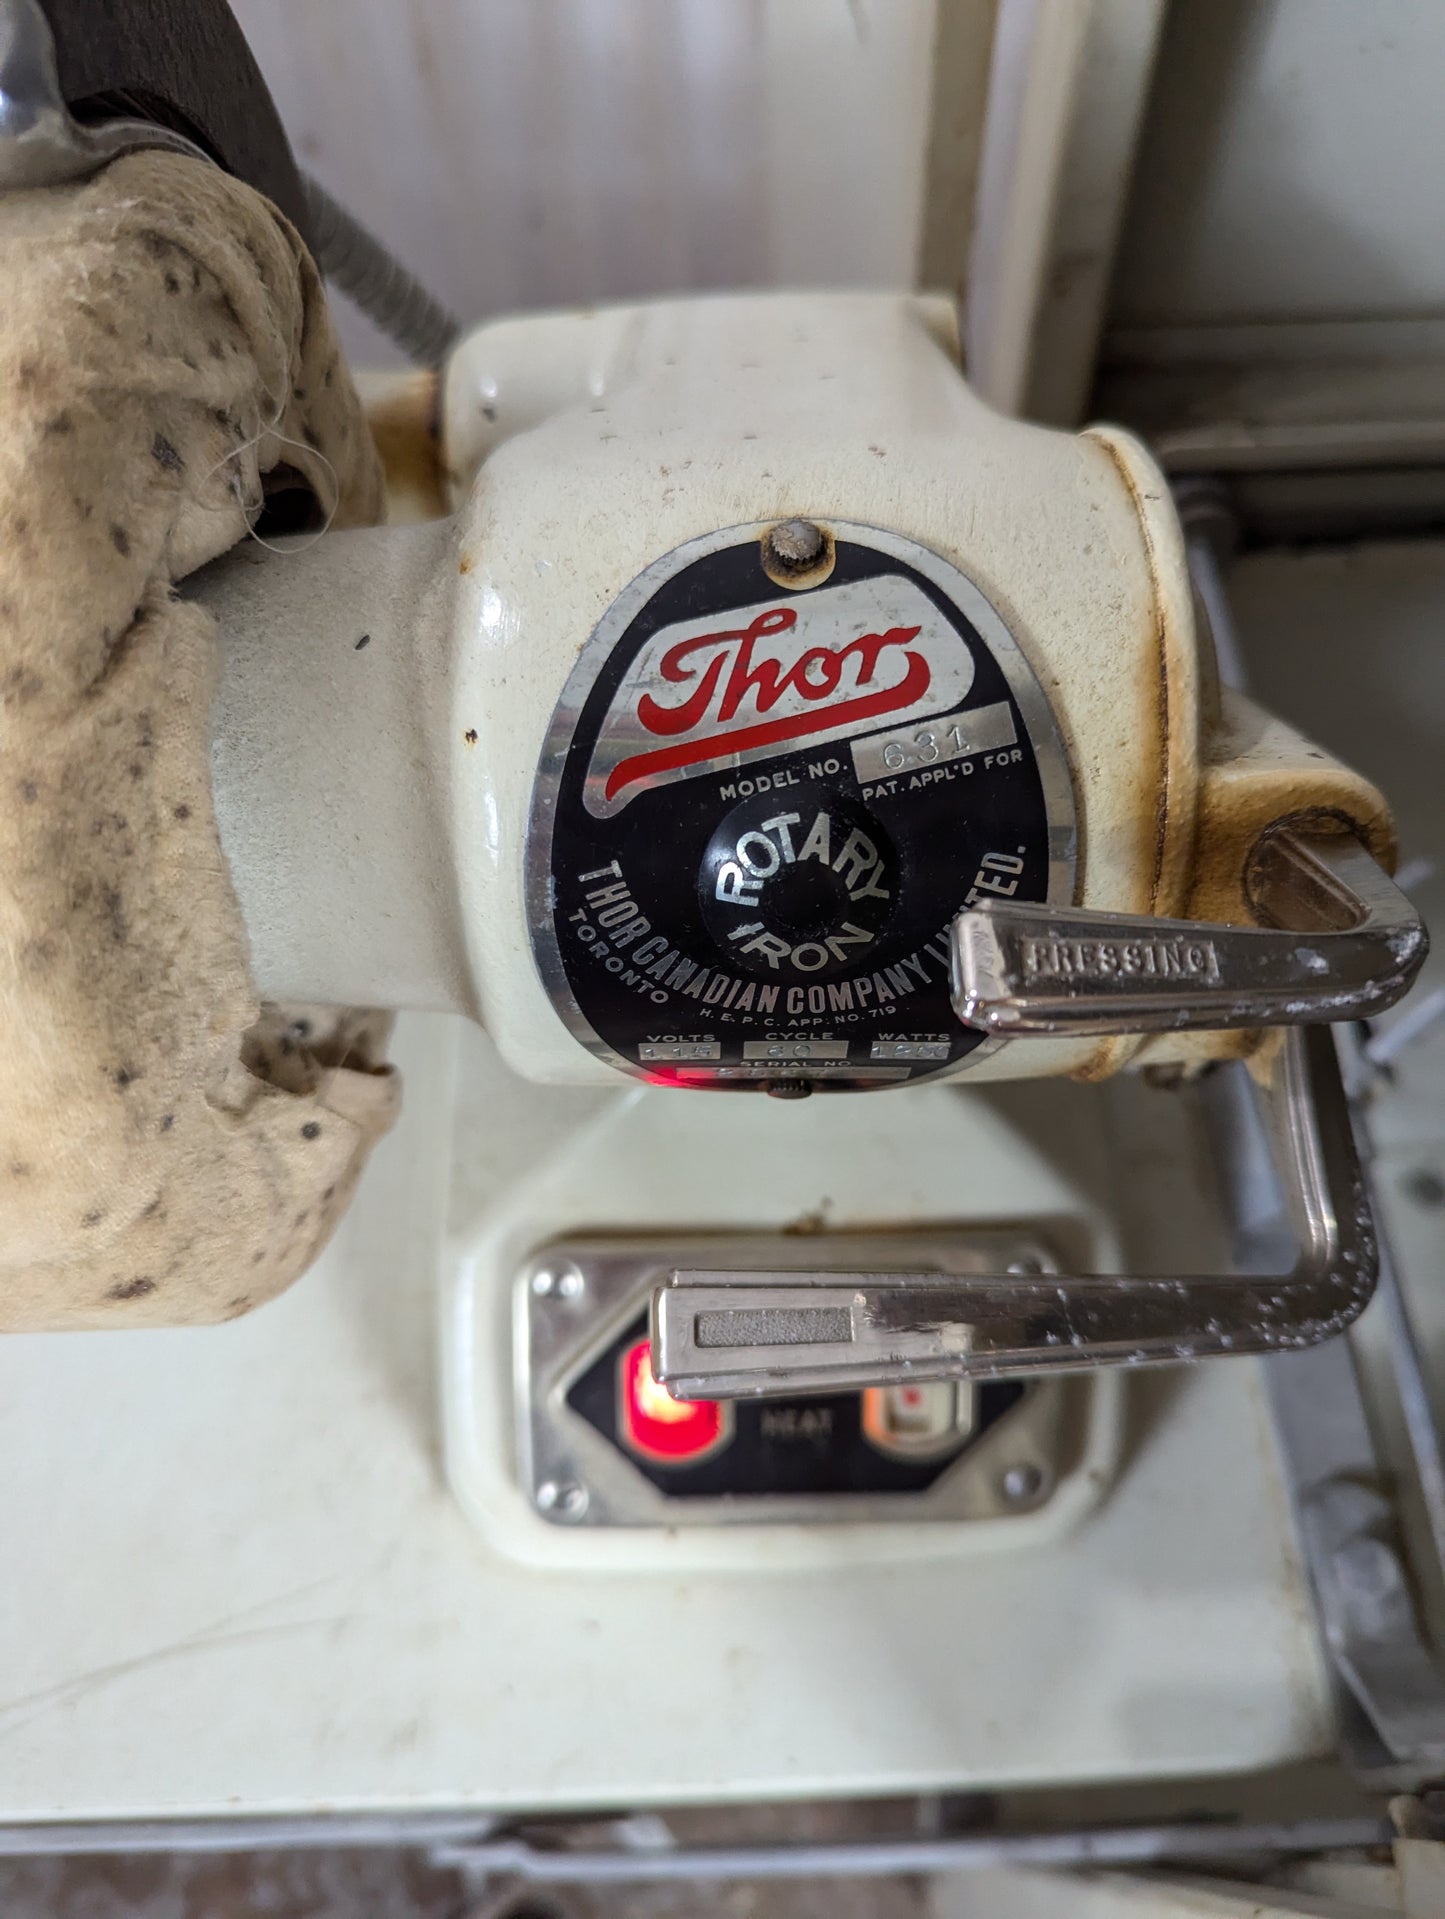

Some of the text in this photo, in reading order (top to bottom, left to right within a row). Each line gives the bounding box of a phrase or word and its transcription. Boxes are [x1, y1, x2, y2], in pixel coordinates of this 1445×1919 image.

[637, 608, 922, 736] Thor
[720, 725, 970, 800] MODEL NO. 631
[984, 749, 1023, 770] FOR
[715, 812, 890, 907] ROTARY
[578, 859, 651, 949] THOR
[632, 936, 780, 1013] CANADIAN
[786, 952, 932, 1014] COMPANY
[727, 921, 875, 971] IRON
[569, 908, 669, 1004] TORONTO
[868, 1005, 897, 1018] 719
[646, 1034, 716, 1043] VOLTS
[765, 1032, 834, 1041] CYCLE
[767, 1045, 811, 1057] 60
[878, 1033, 950, 1041] WATTS
